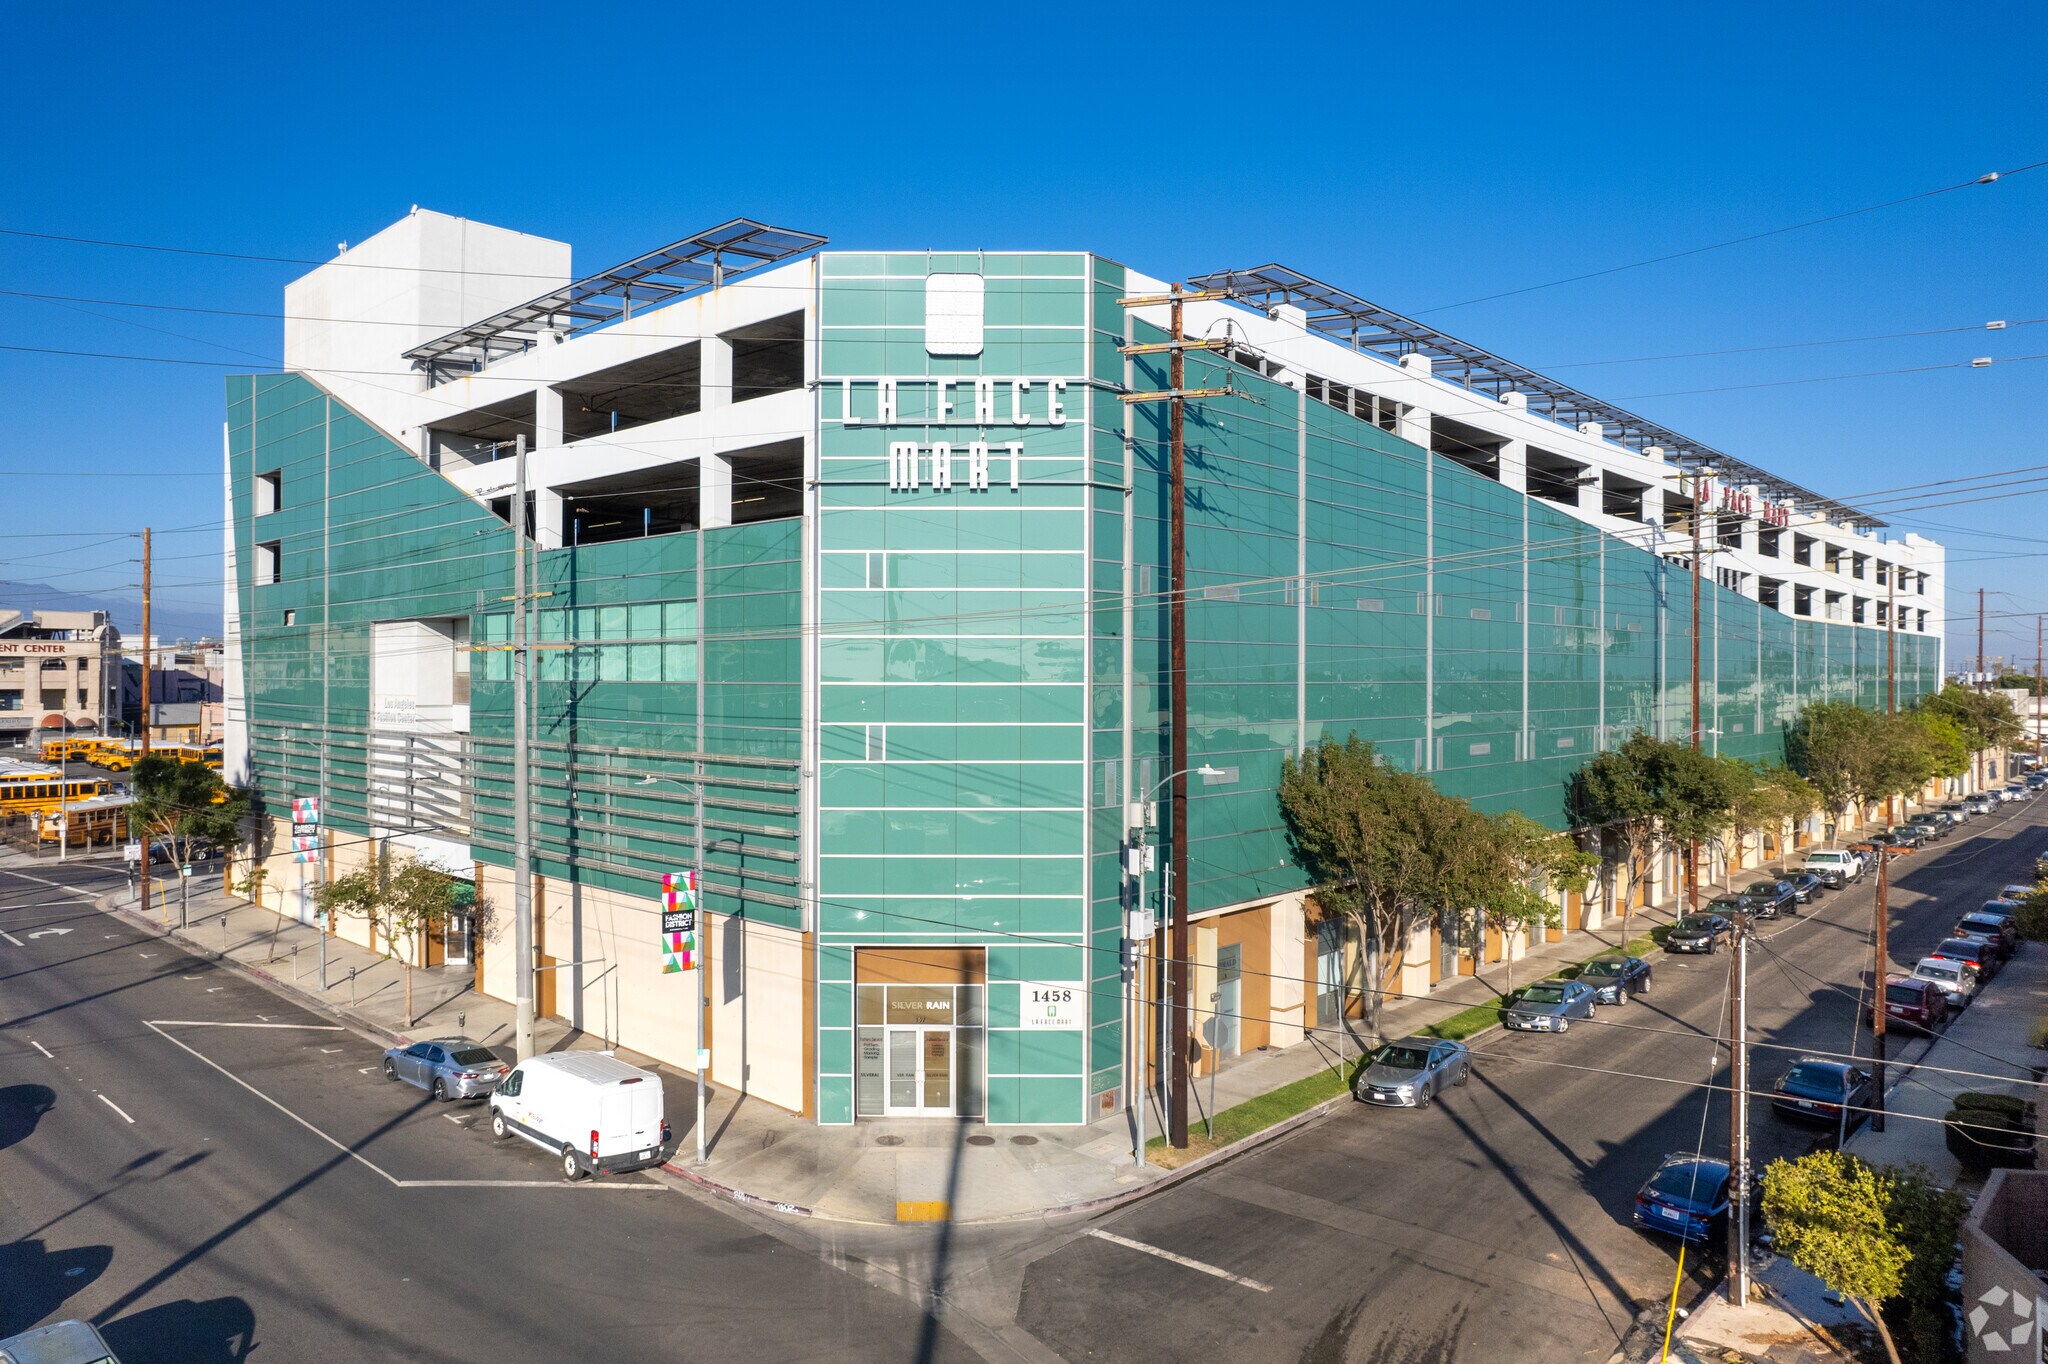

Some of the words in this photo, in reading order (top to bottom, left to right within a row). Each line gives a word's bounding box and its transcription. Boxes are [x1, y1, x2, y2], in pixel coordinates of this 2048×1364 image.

[842, 377, 897, 425] LA
[937, 377, 1067, 425] FACE
[890, 441, 1024, 490] MART
[24, 644, 66, 653] CENTER
[665, 912, 693, 921] FASHION
[665, 919, 692, 928] DISTRICT
[1032, 990, 1072, 1003] 1458
[891, 1001, 923, 1010] SILVER
[926, 1001, 950, 1010] RAIN
